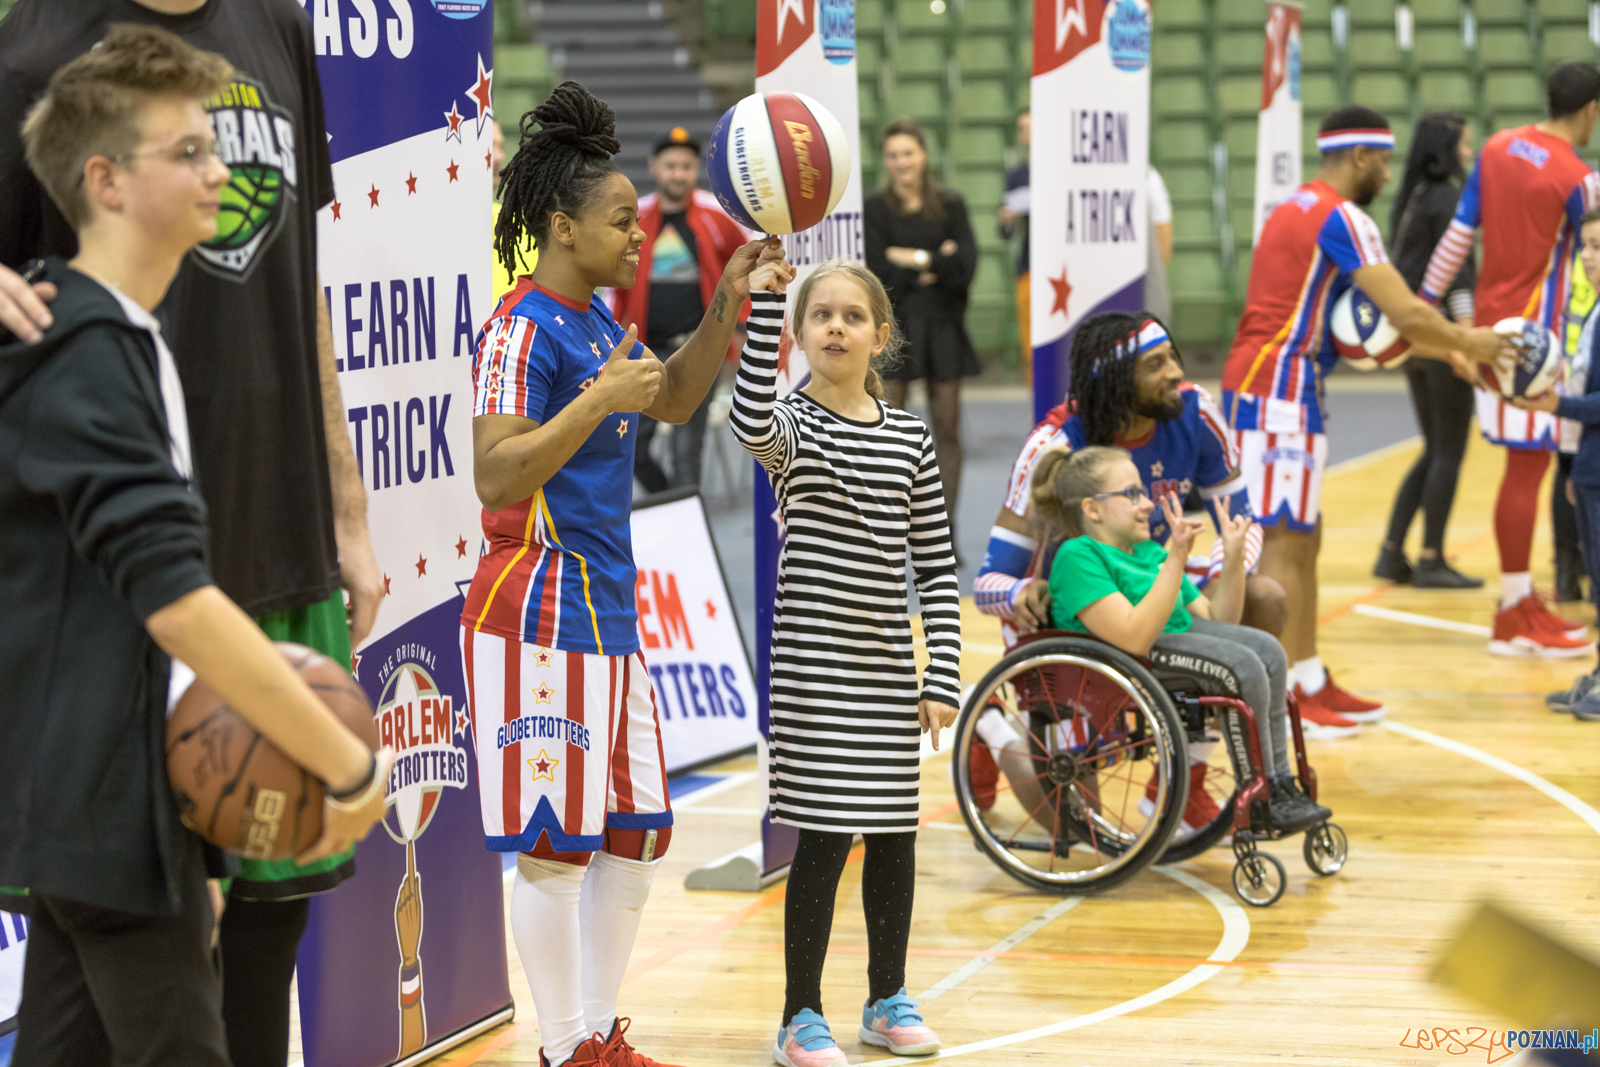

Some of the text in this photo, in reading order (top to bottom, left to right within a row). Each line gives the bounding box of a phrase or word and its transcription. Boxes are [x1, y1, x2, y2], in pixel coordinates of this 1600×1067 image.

[301, 0, 414, 59] ASS
[1070, 109, 1129, 164] LEARN
[1065, 189, 1136, 244] A TRICK
[453, 273, 474, 358] A
[348, 393, 455, 491] TRICK
[378, 642, 437, 685] THE ORIGINAL
[1168, 654, 1202, 671] SMILE
[497, 715, 590, 751] GLOBETROTTERS
